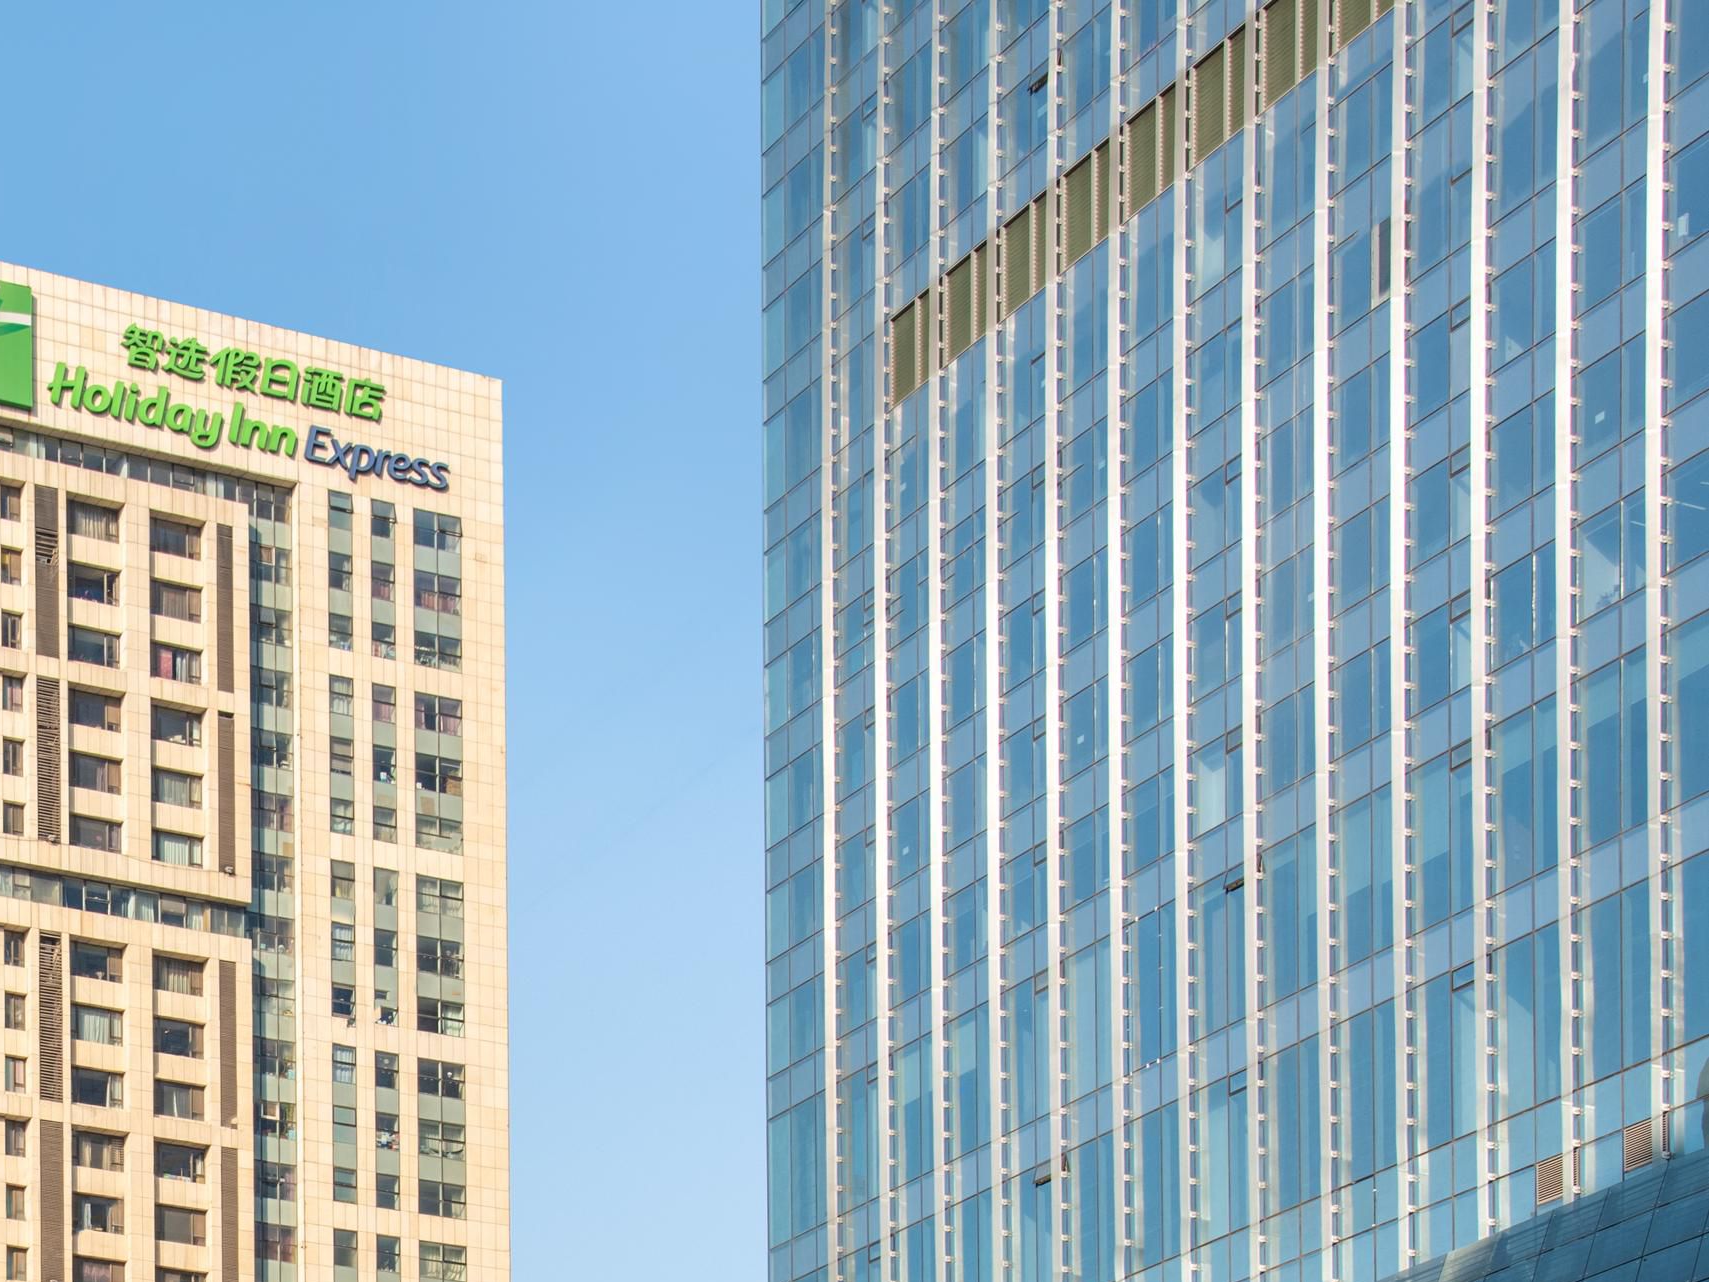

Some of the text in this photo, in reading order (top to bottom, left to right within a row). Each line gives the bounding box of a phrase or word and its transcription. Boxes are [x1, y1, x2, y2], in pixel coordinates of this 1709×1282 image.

[48, 362, 450, 491] Holiday Inn Express
[122, 322, 387, 421] 智选假日酒店
